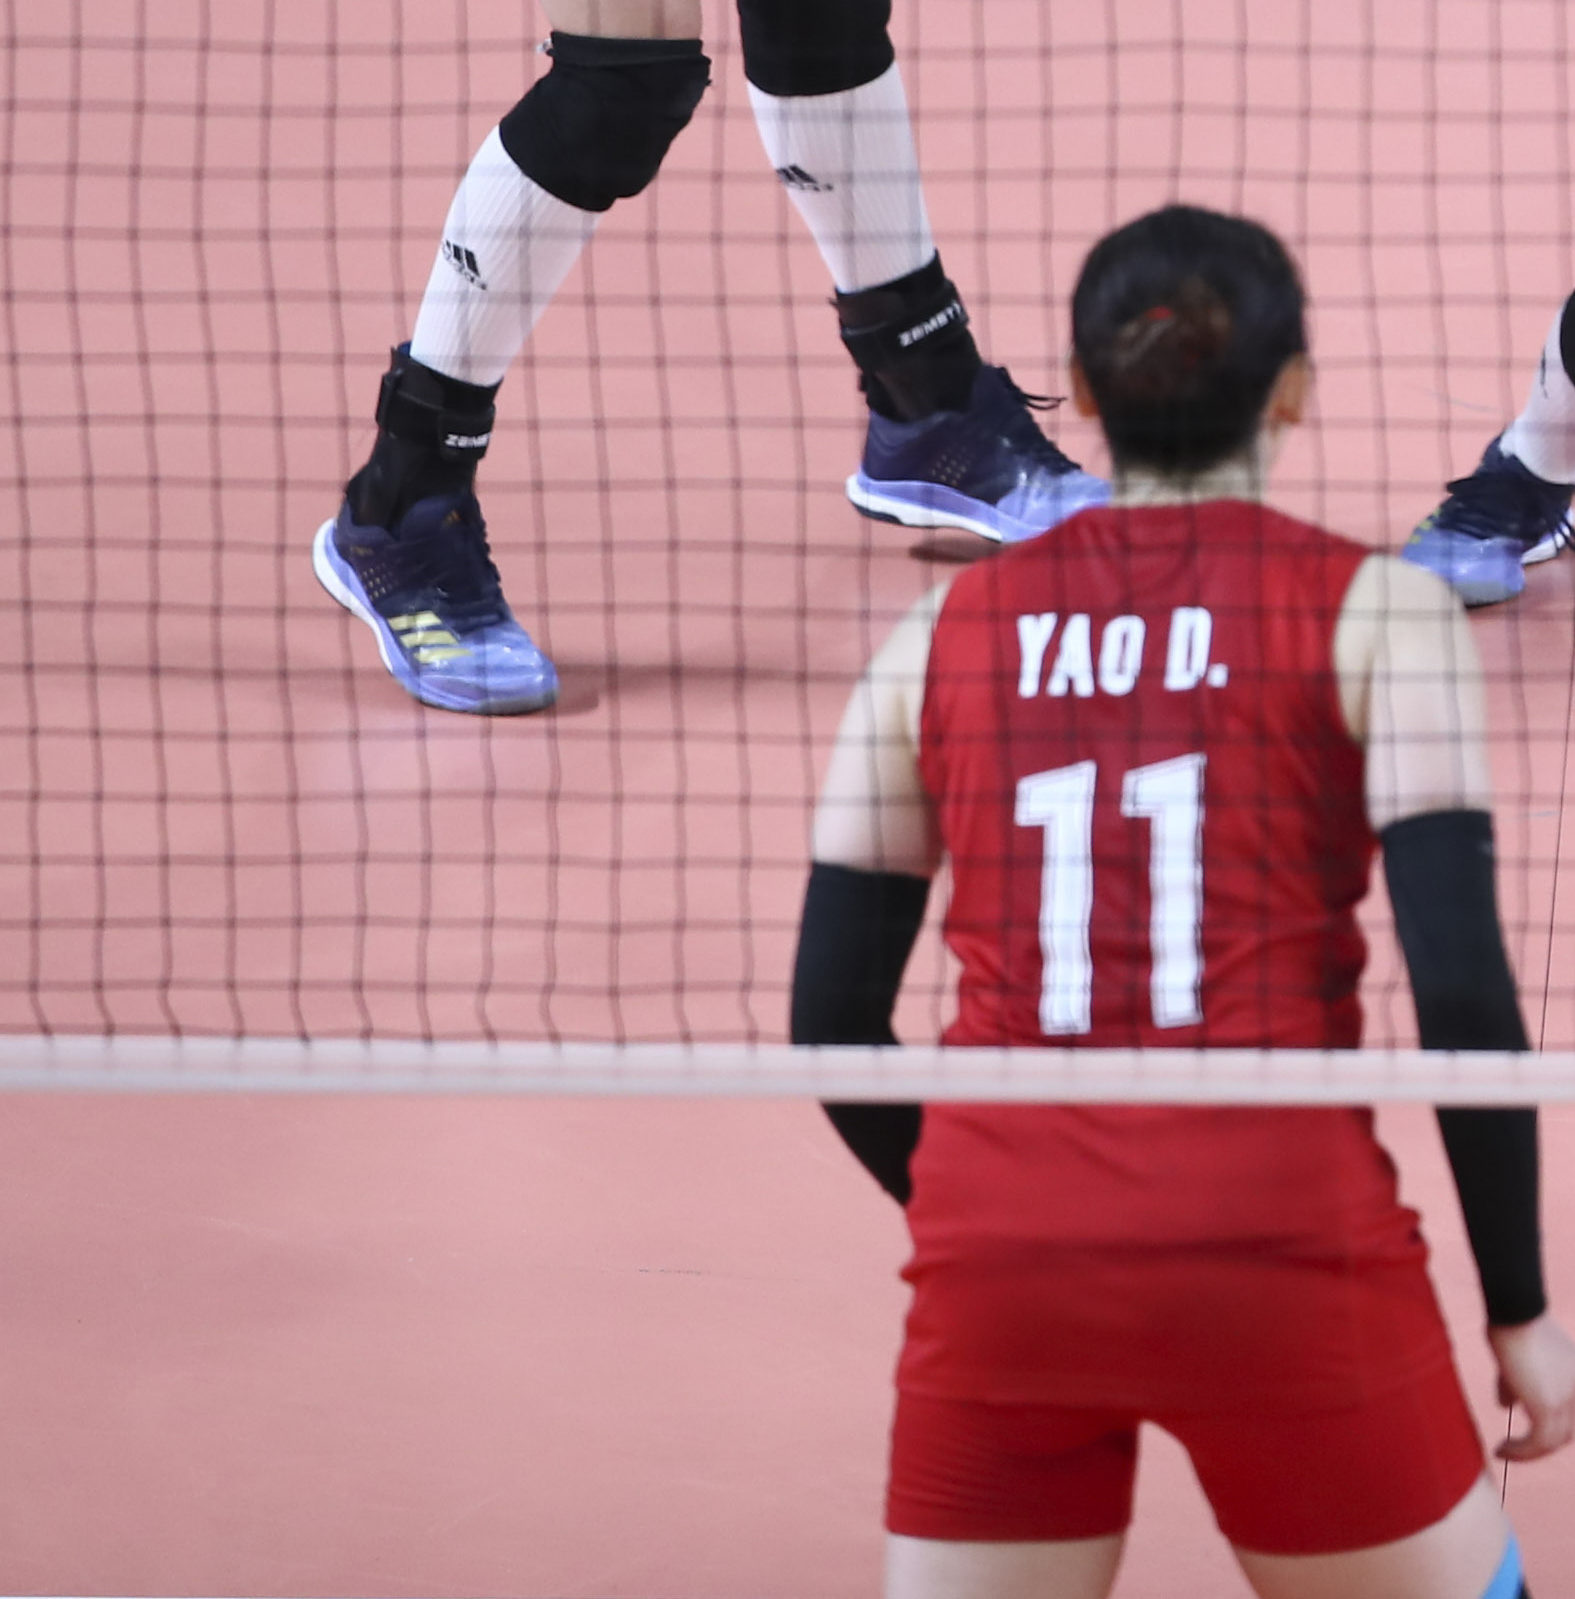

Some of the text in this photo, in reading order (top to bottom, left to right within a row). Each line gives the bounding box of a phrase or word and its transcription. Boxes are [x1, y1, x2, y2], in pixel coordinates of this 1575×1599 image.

[1016, 605, 1229, 699] YAO D.
[1013, 751, 1208, 1036] 11
